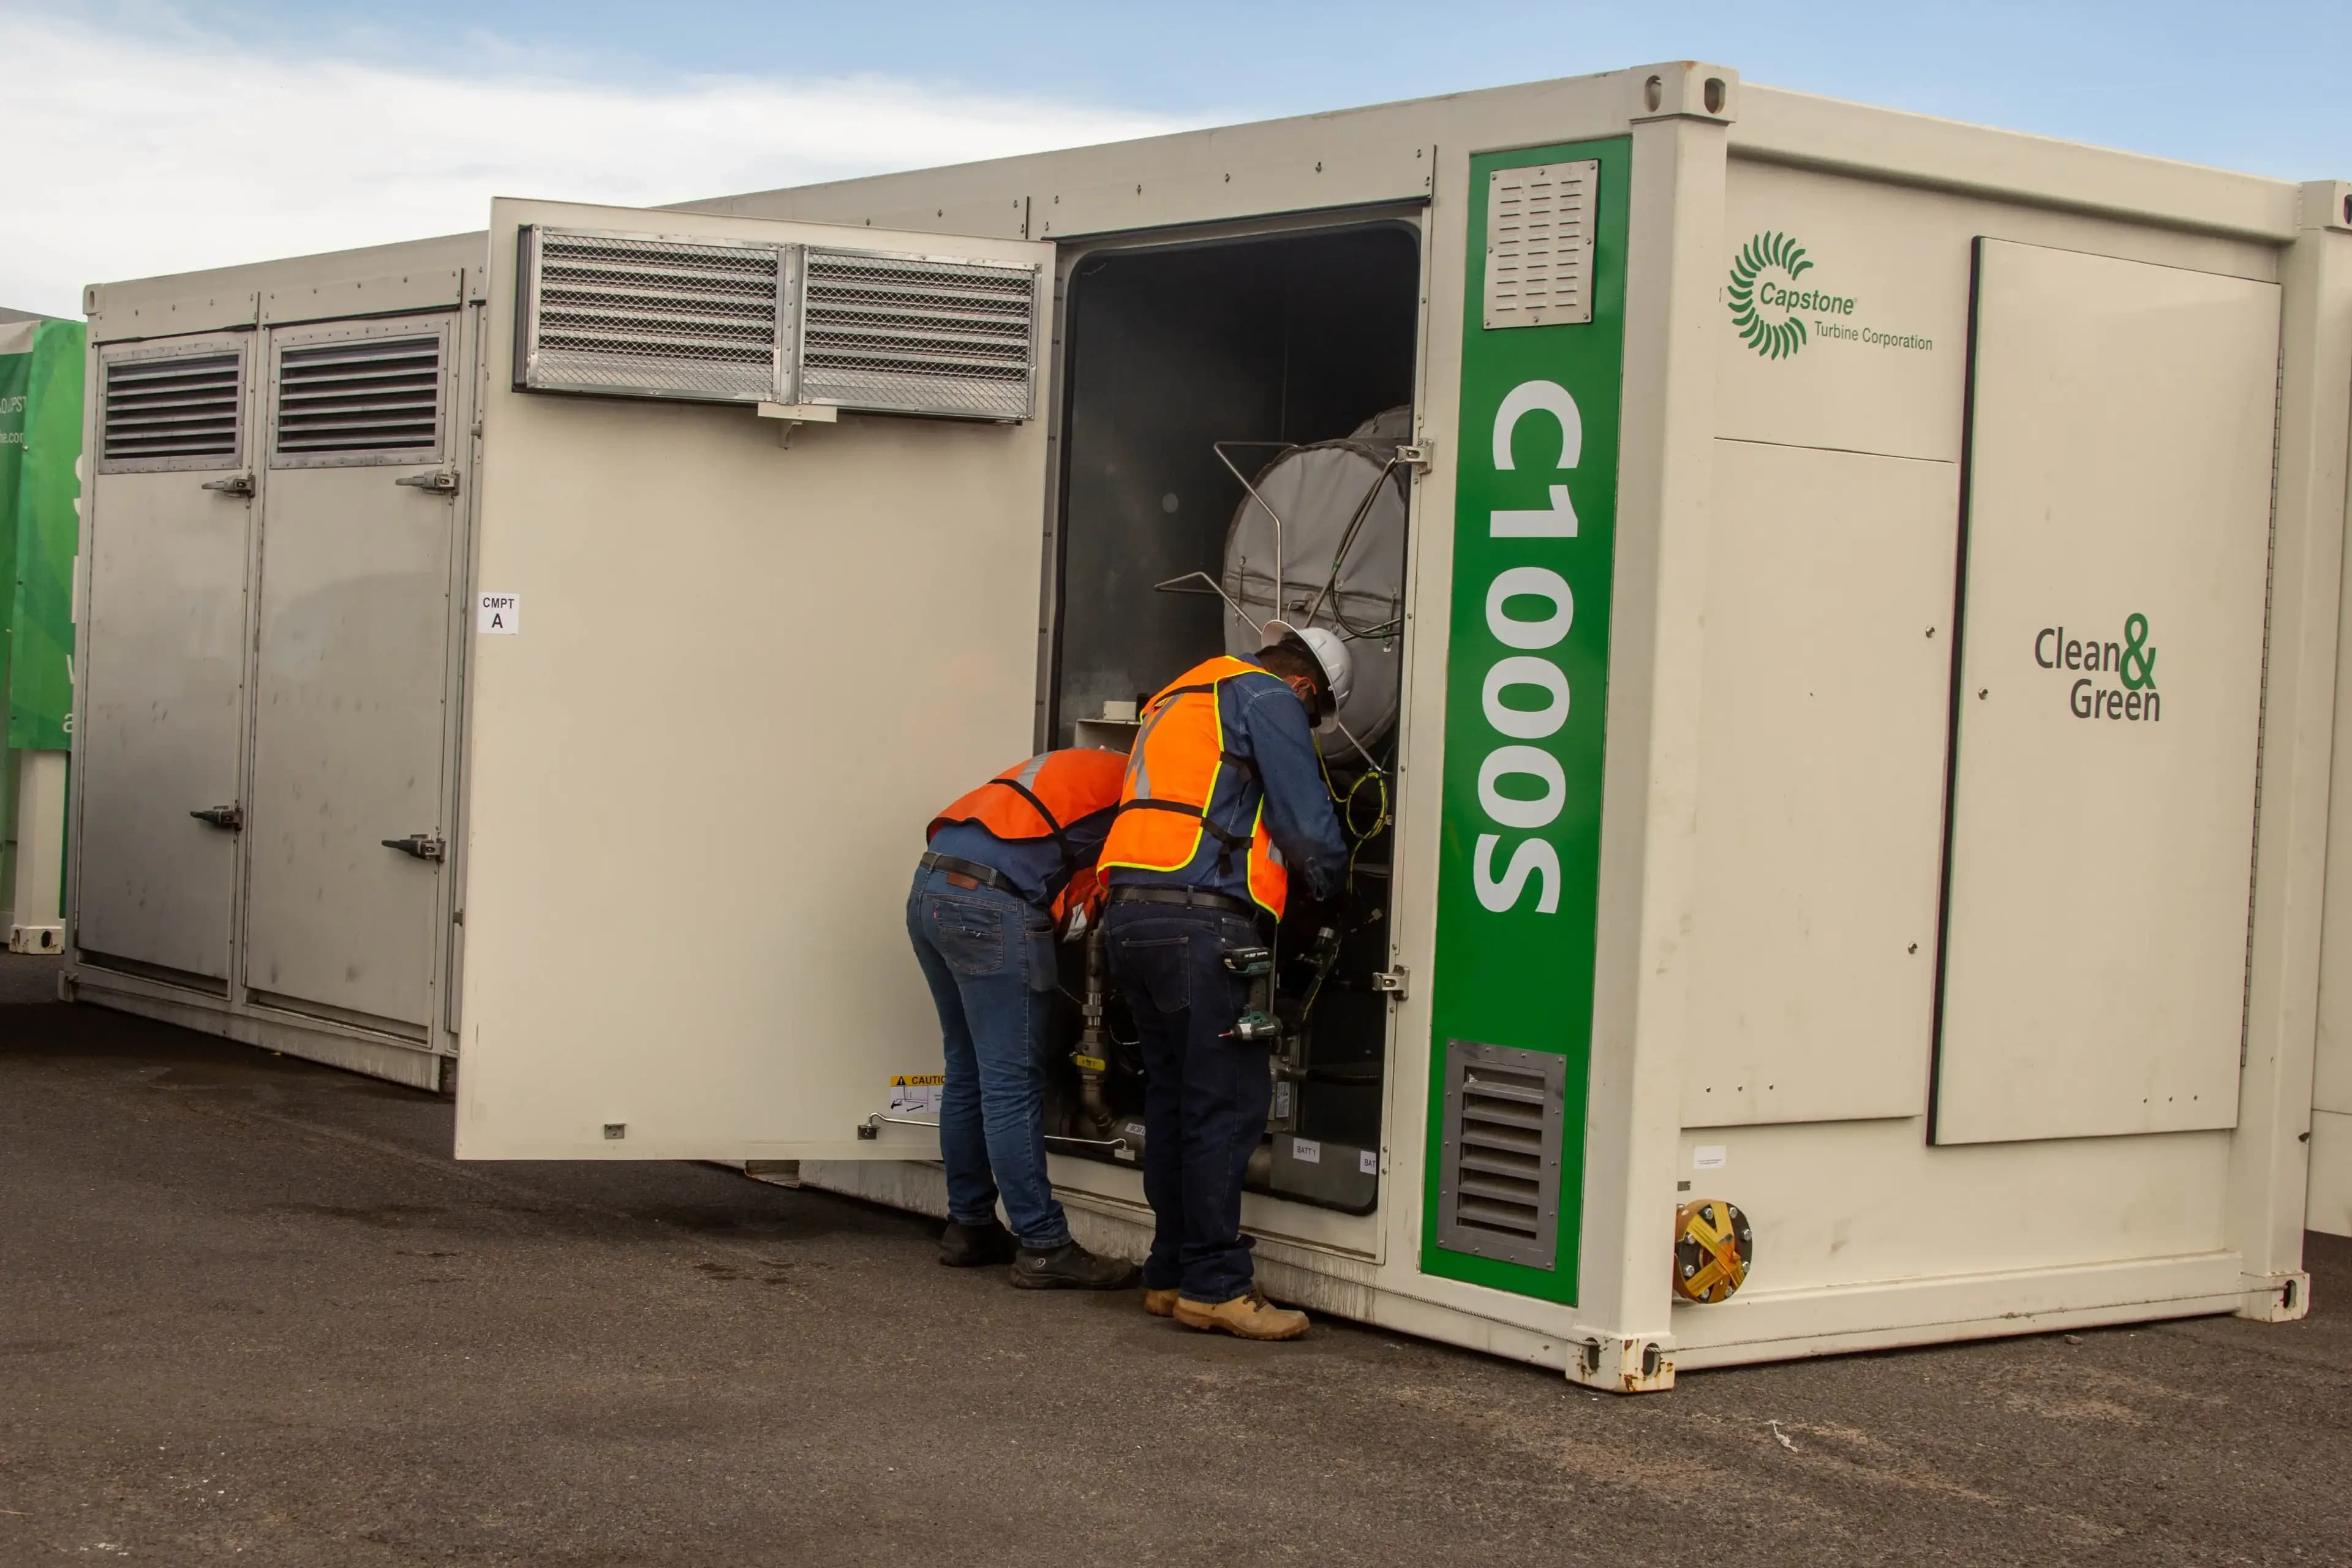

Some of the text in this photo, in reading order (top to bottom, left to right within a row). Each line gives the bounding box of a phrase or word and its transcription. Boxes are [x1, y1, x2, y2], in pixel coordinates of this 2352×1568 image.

[1760, 282, 1854, 315] Capstone
[1814, 321, 1933, 350] Turbine Corporation
[483, 597, 515, 609] CMPT
[491, 613, 503, 628] A
[1473, 380, 1582, 914] C1000S
[2070, 679, 2160, 722] Green
[911, 1076, 946, 1084] CAUTIO
[1297, 1146, 1312, 1155] BATT
[1364, 1159, 1376, 1168] BAT
